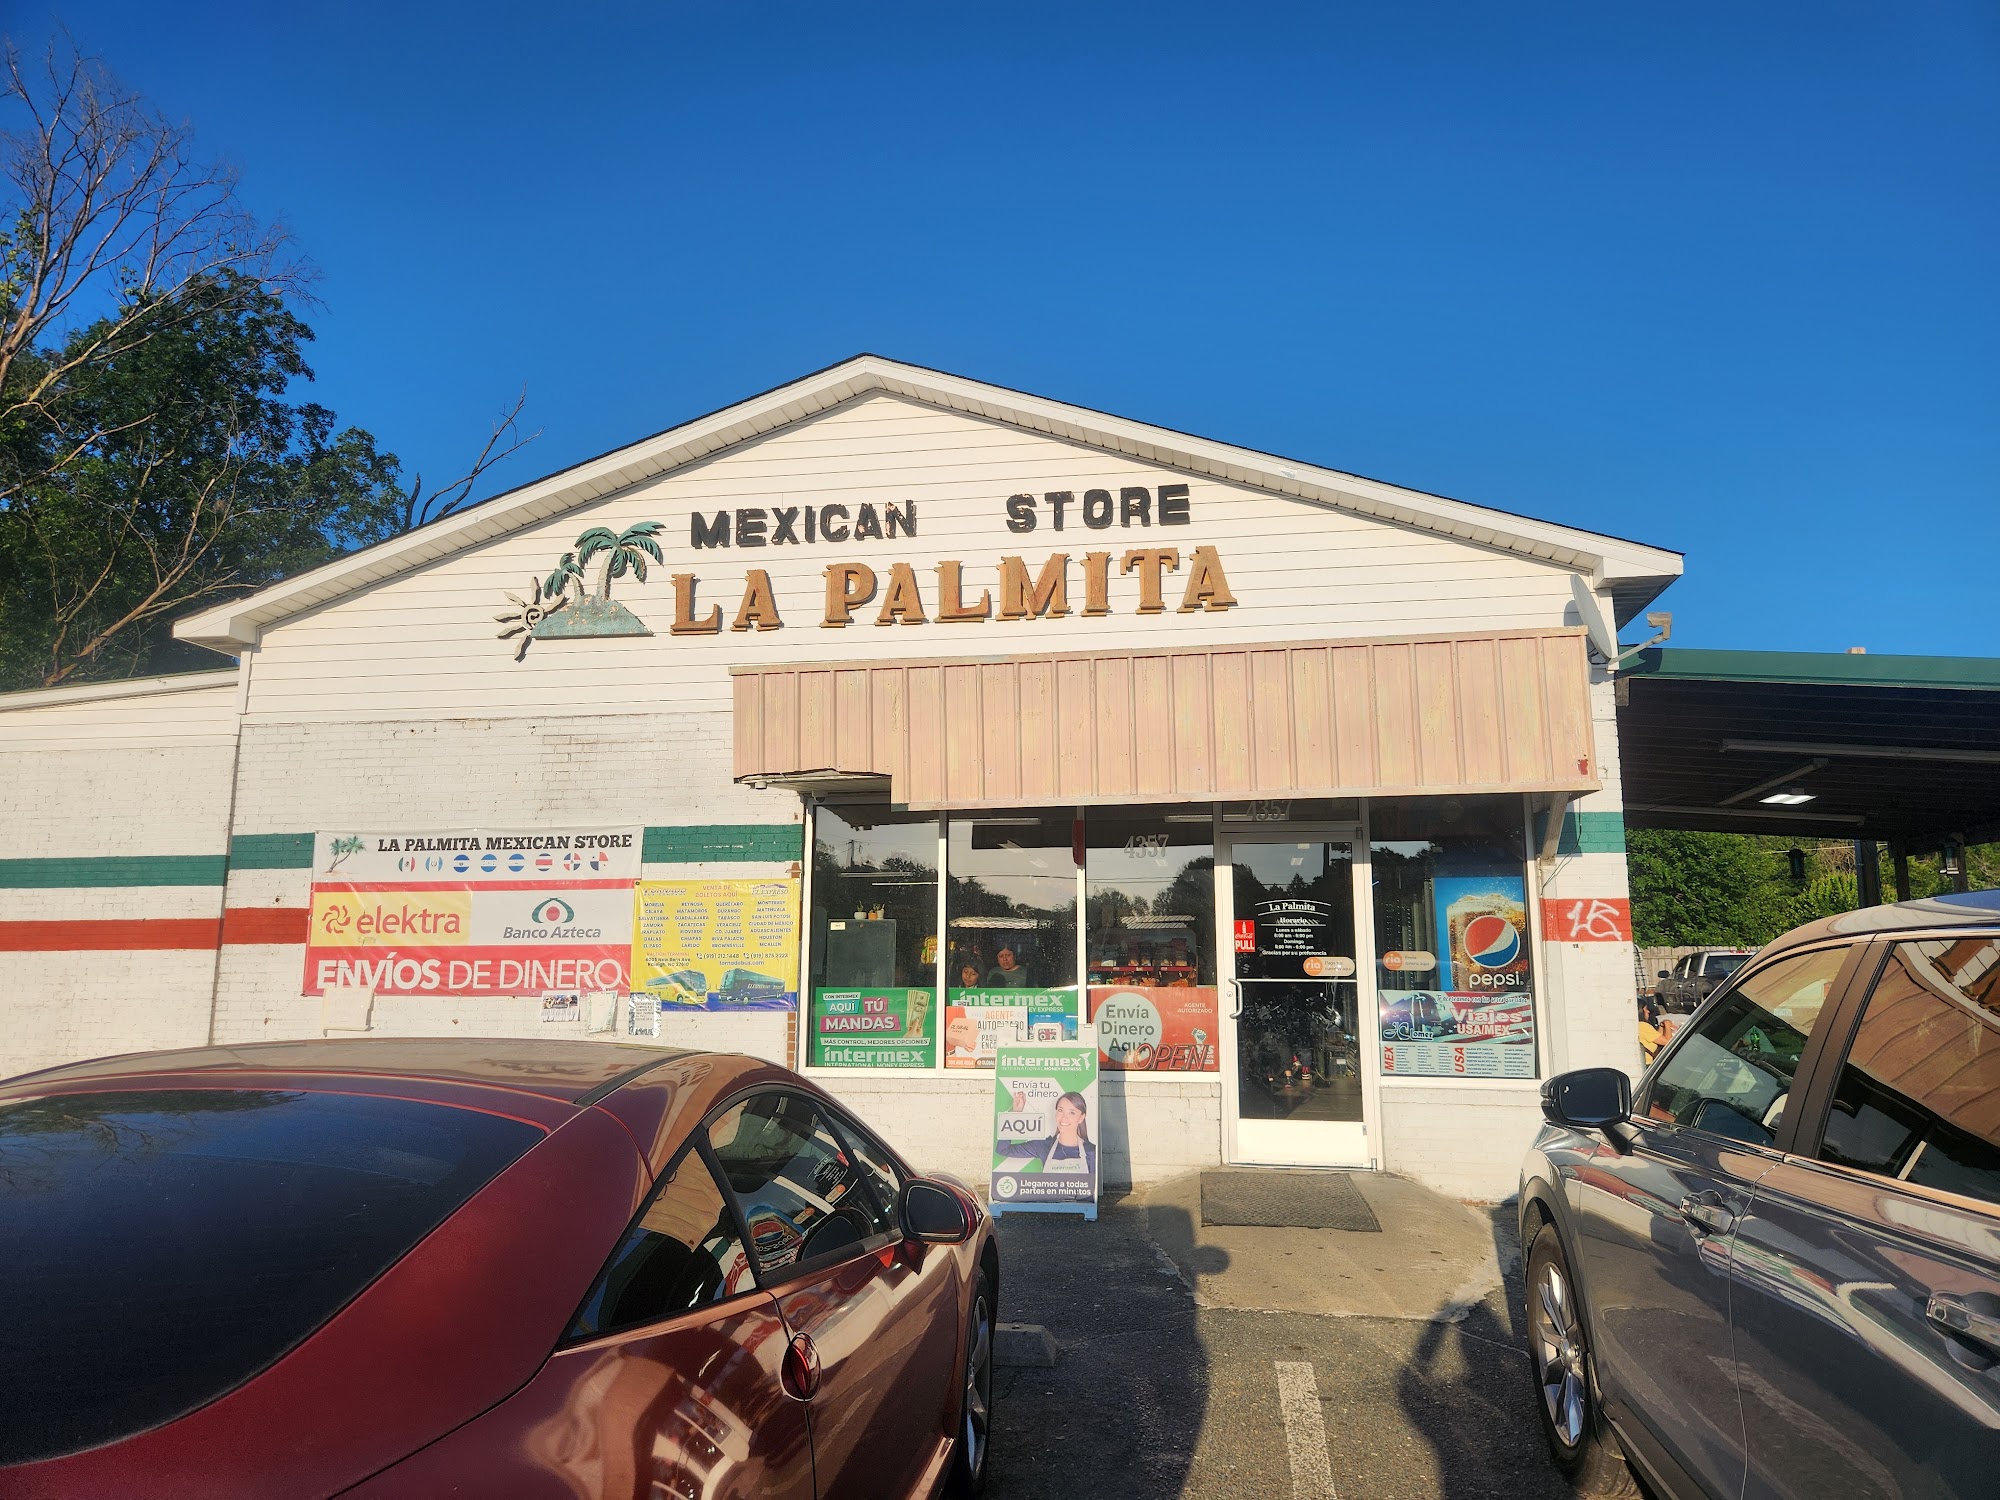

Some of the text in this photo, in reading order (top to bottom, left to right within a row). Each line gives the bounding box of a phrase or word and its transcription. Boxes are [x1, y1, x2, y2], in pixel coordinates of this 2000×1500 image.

[691, 484, 1190, 549] MEXICAN STORE
[670, 545, 1238, 636] LA PALMITA
[378, 834, 633, 852] LA PALMITA MEXICAN STORE
[1124, 834, 1169, 858] 4357
[1282, 902, 1316, 911] Palmita
[356, 904, 460, 934] elektra
[503, 926, 601, 939] Banco Azteca
[1235, 940, 1255, 950] PULL
[1306, 960, 1320, 969] ria
[1386, 954, 1400, 963] ria
[316, 952, 622, 989] ENVÍOS DE DINERO
[1469, 971, 1520, 988] pepsi
[830, 998, 883, 1013] AQUÍ TÚ
[1106, 1004, 1149, 1018] Envía
[985, 1010, 1014, 1020] AGENTE
[1451, 1009, 1523, 1025] Viajes
[826, 1016, 894, 1030] MANDAS
[1101, 1021, 1154, 1035] Dinero
[1457, 1024, 1510, 1036] USA/MEX
[825, 1046, 924, 1062] intermex
[1002, 1054, 1081, 1066] intermex
[1134, 1043, 1207, 1070] OPEN
[1384, 1046, 1394, 1071] MEX
[1454, 1047, 1464, 1072] USA
[1028, 1089, 1058, 1097] dinero
[1001, 1116, 1042, 1134] AQUÍ
[1020, 1180, 1058, 1188] Llegamos
